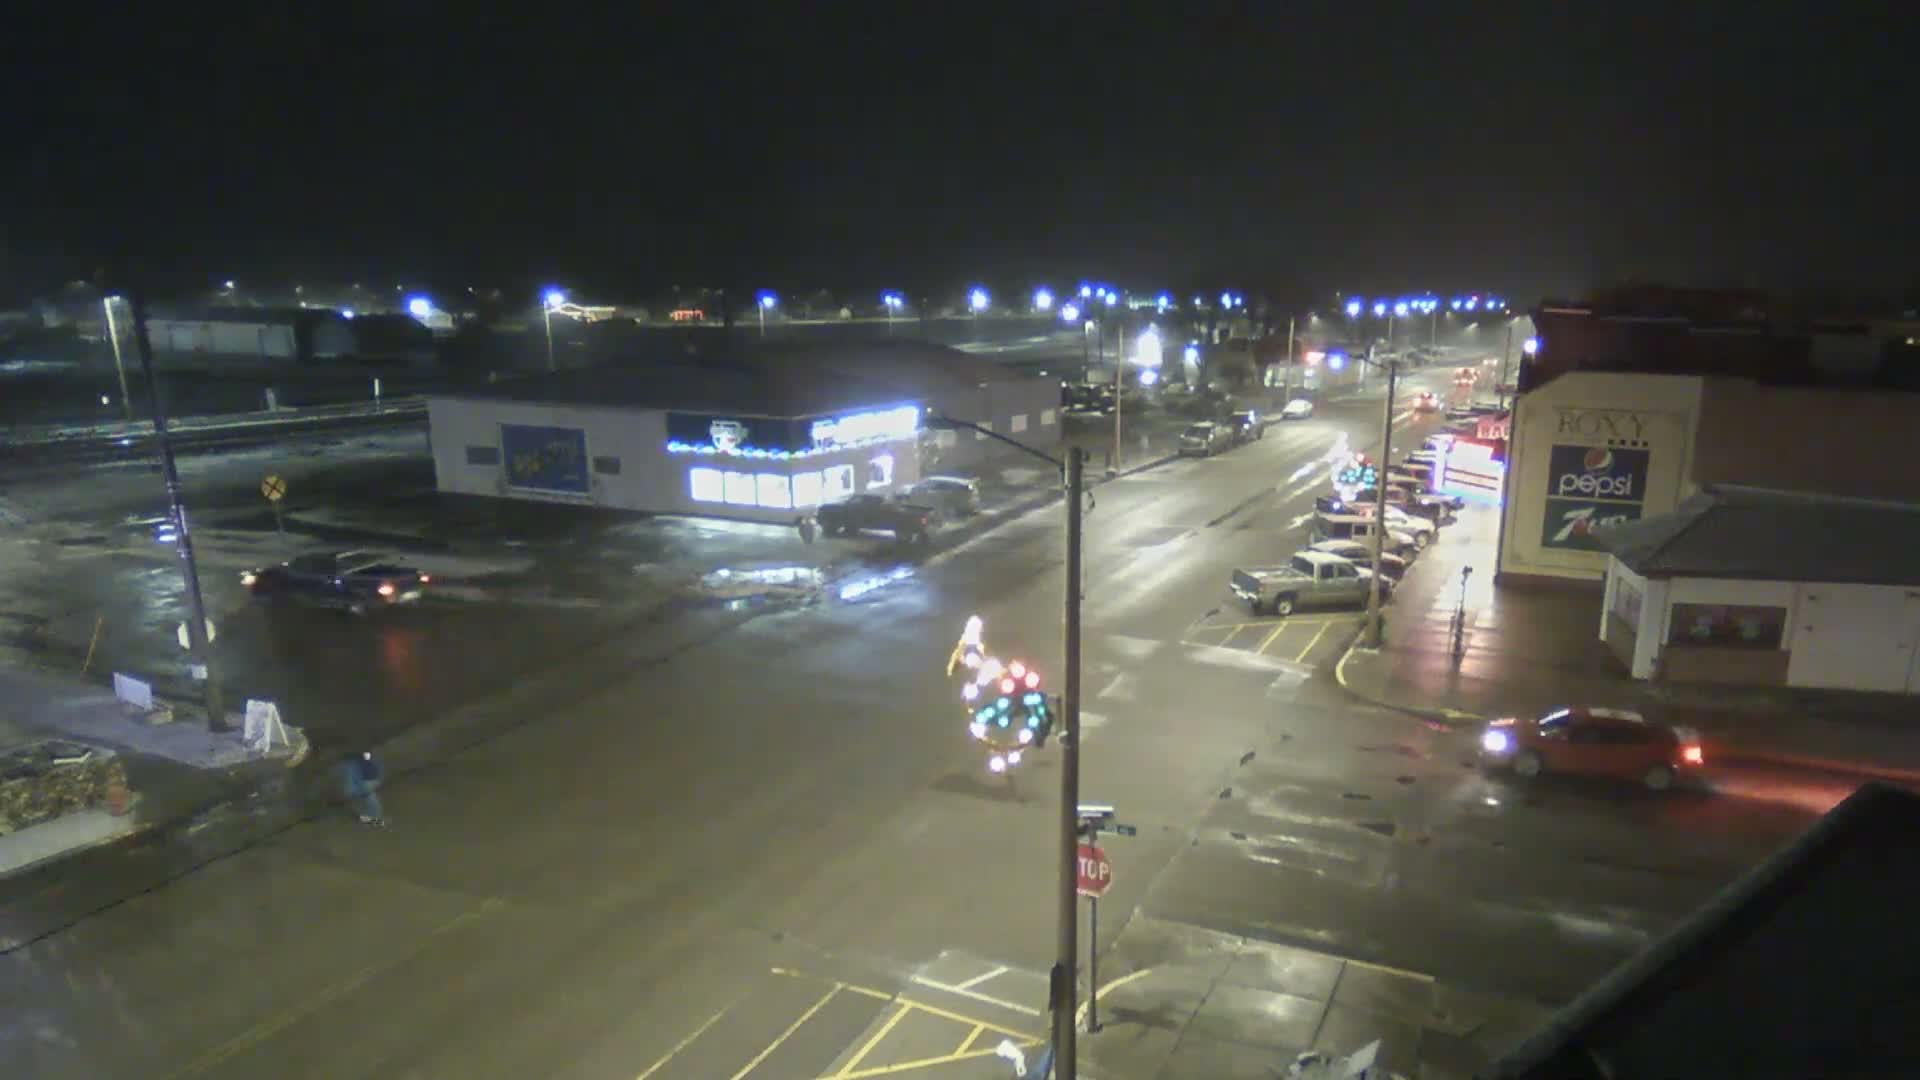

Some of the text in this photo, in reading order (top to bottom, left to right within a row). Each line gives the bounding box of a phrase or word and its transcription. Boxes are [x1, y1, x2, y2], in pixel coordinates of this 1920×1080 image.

[1558, 411, 1648, 437] ROXY
[1559, 473, 1633, 497] pepsi
[1078, 857, 1109, 880] TOP
